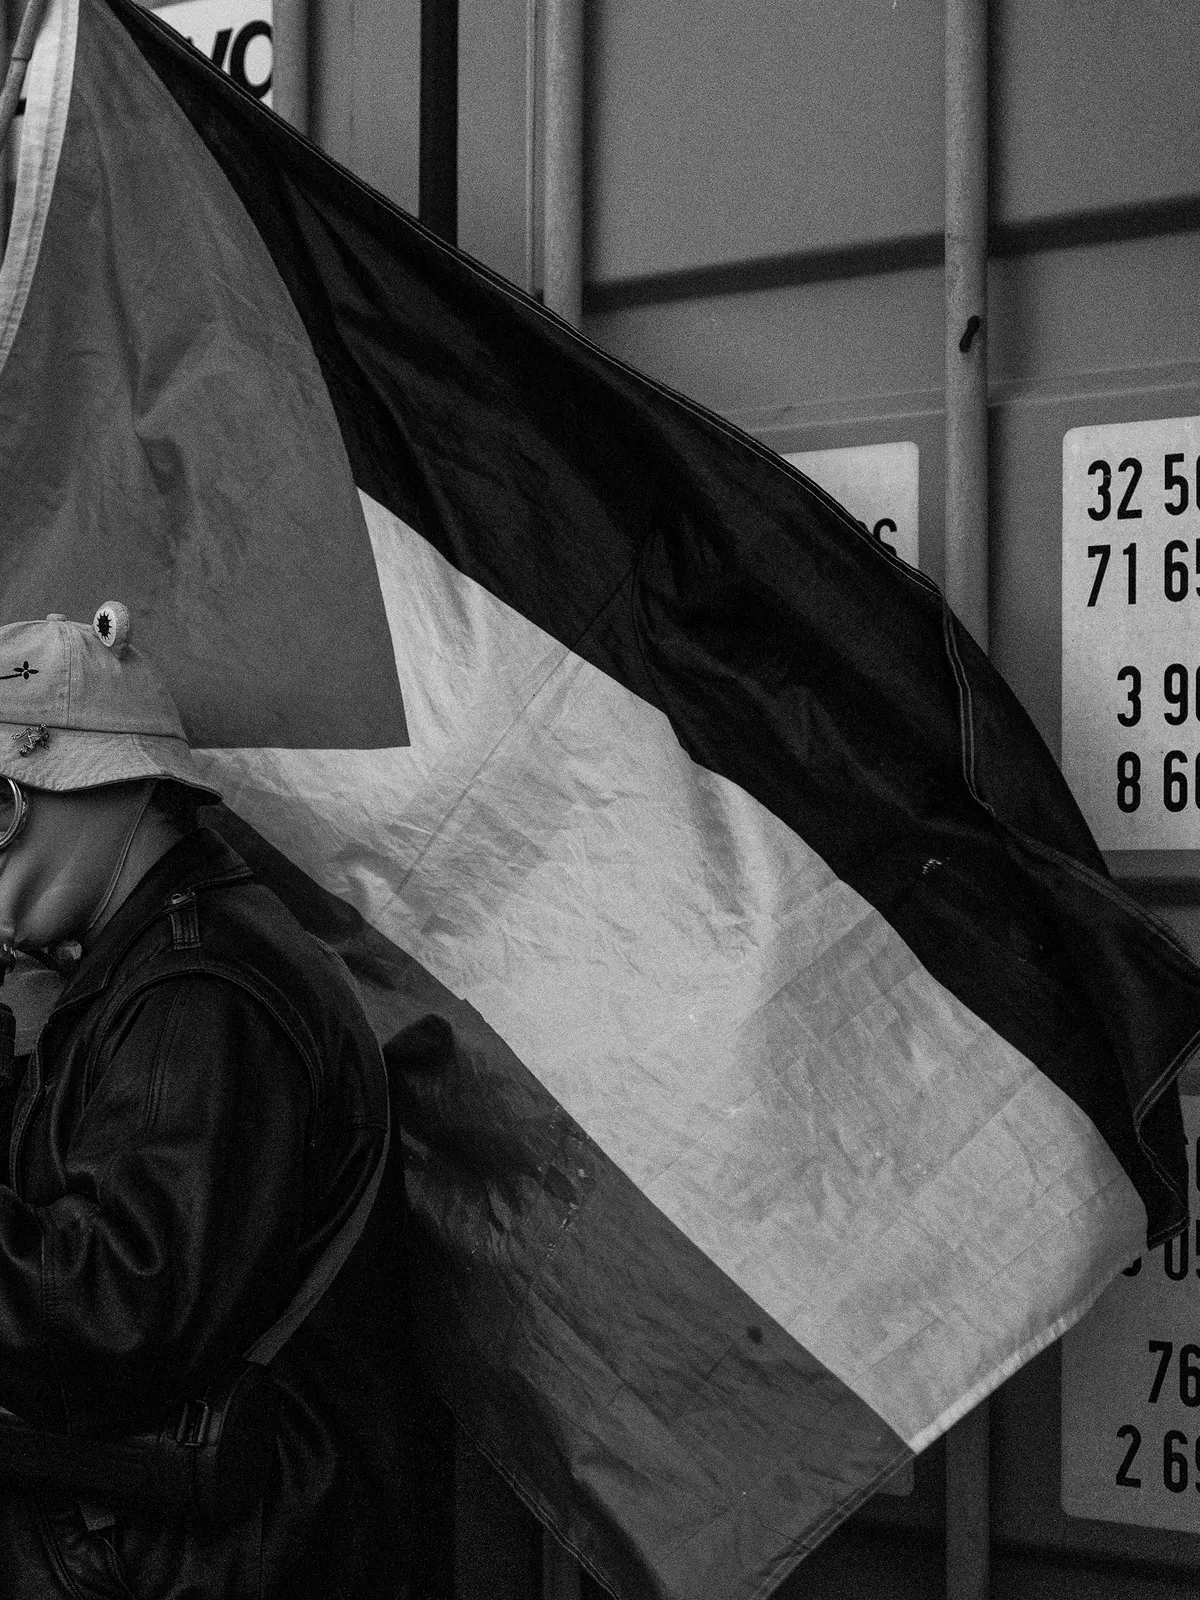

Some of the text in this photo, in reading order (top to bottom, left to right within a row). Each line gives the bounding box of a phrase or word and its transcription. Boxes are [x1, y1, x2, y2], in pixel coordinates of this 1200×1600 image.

[1086, 453, 1200, 521] 32 5
[1086, 541, 1138, 607] 71
[1116, 662, 1200, 727] 3 9
[1116, 748, 1200, 814] 8 6
[1115, 1424, 1142, 1489] 2
